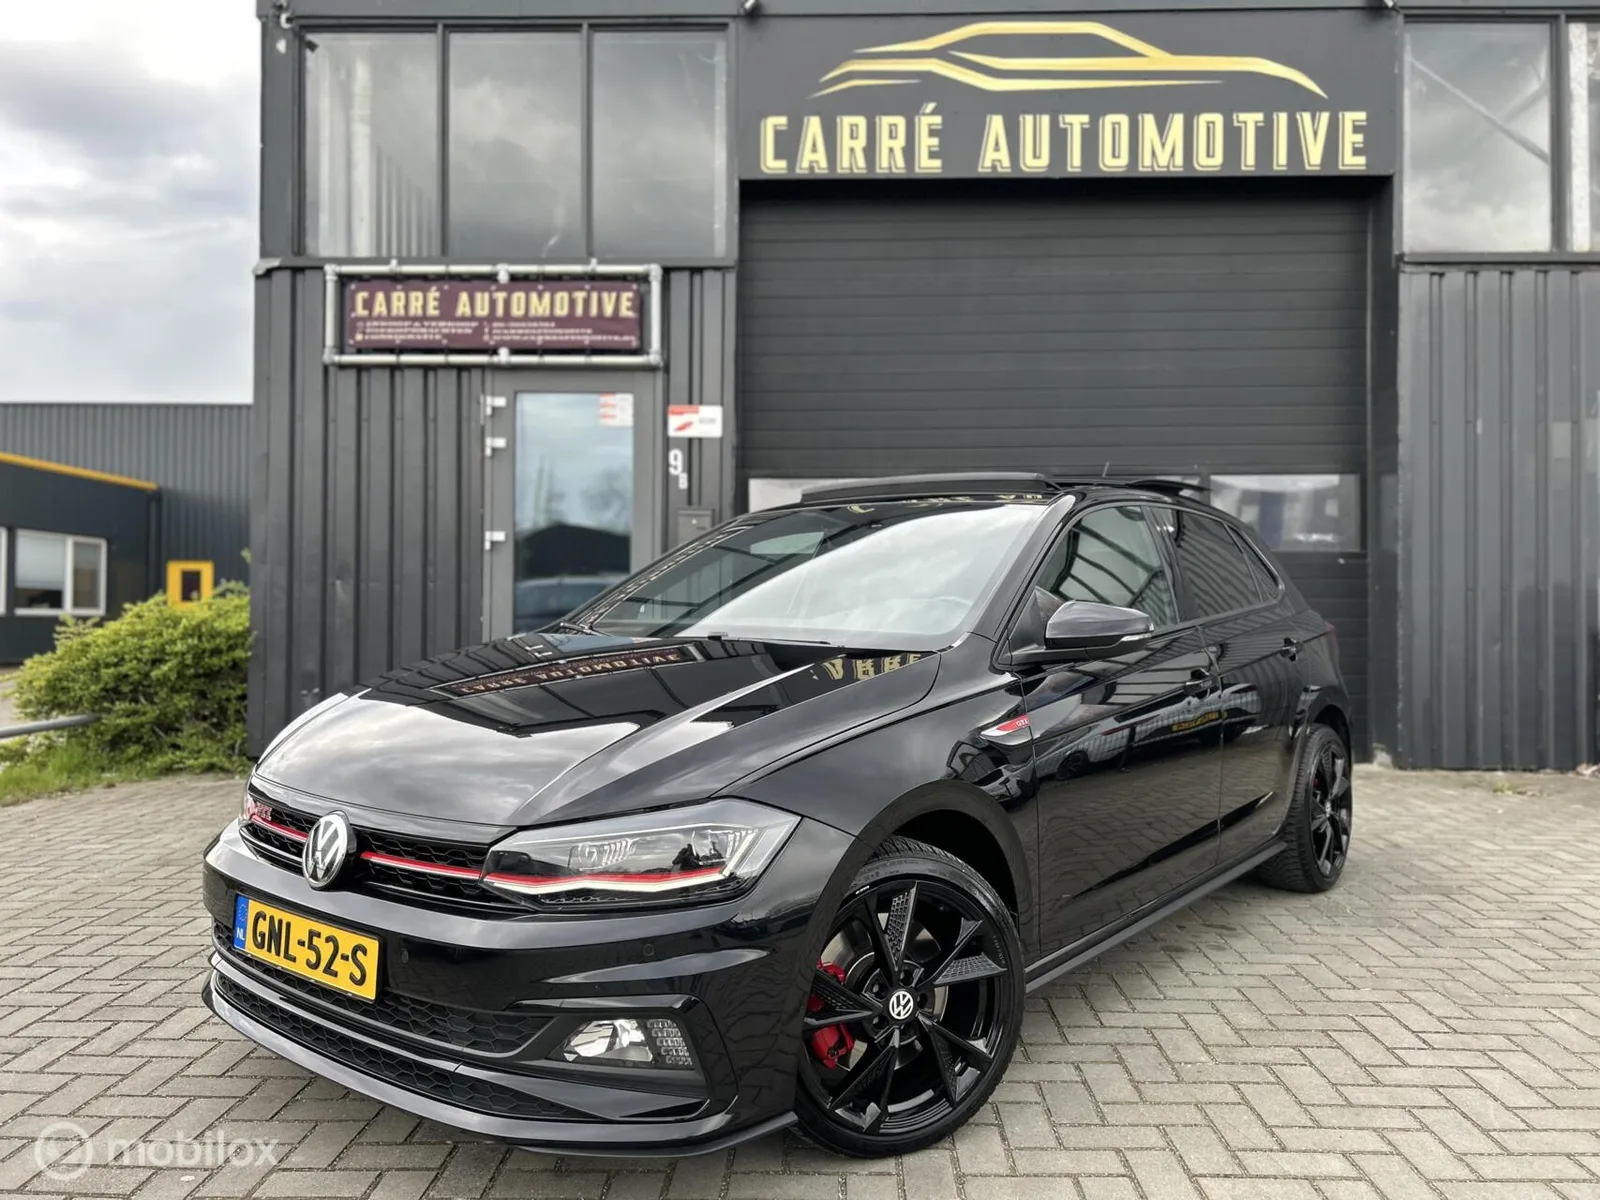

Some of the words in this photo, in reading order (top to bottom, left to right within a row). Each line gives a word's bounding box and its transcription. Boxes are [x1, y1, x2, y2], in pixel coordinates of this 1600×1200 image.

[760, 103, 943, 174] CARRÉ
[978, 111, 1367, 173] AUTOMOTIVE
[355, 286, 440, 317] CARRÉ
[455, 290, 634, 318] AUTOMOTIVE
[236, 927, 246, 941] NL
[252, 910, 368, 987] GNL-52-S
